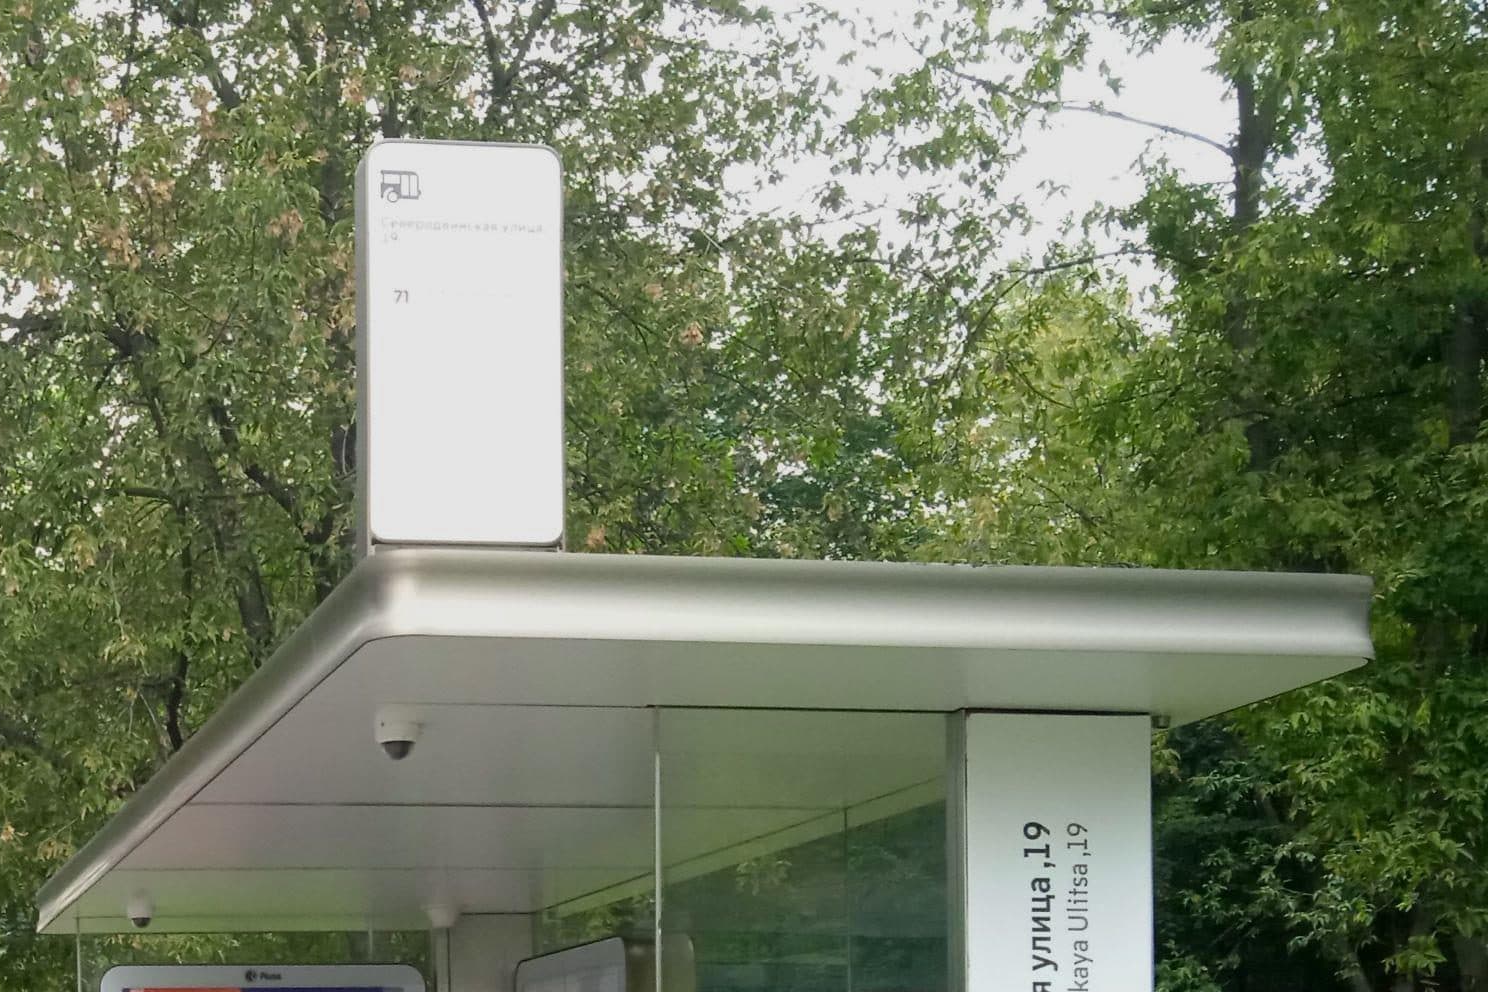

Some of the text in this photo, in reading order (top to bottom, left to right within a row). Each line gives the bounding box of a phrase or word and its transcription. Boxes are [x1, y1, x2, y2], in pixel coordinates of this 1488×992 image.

[393, 289, 409, 304] 71
[1029, 876, 1060, 972] улица
[1065, 863, 1089, 932] Ulitsa
